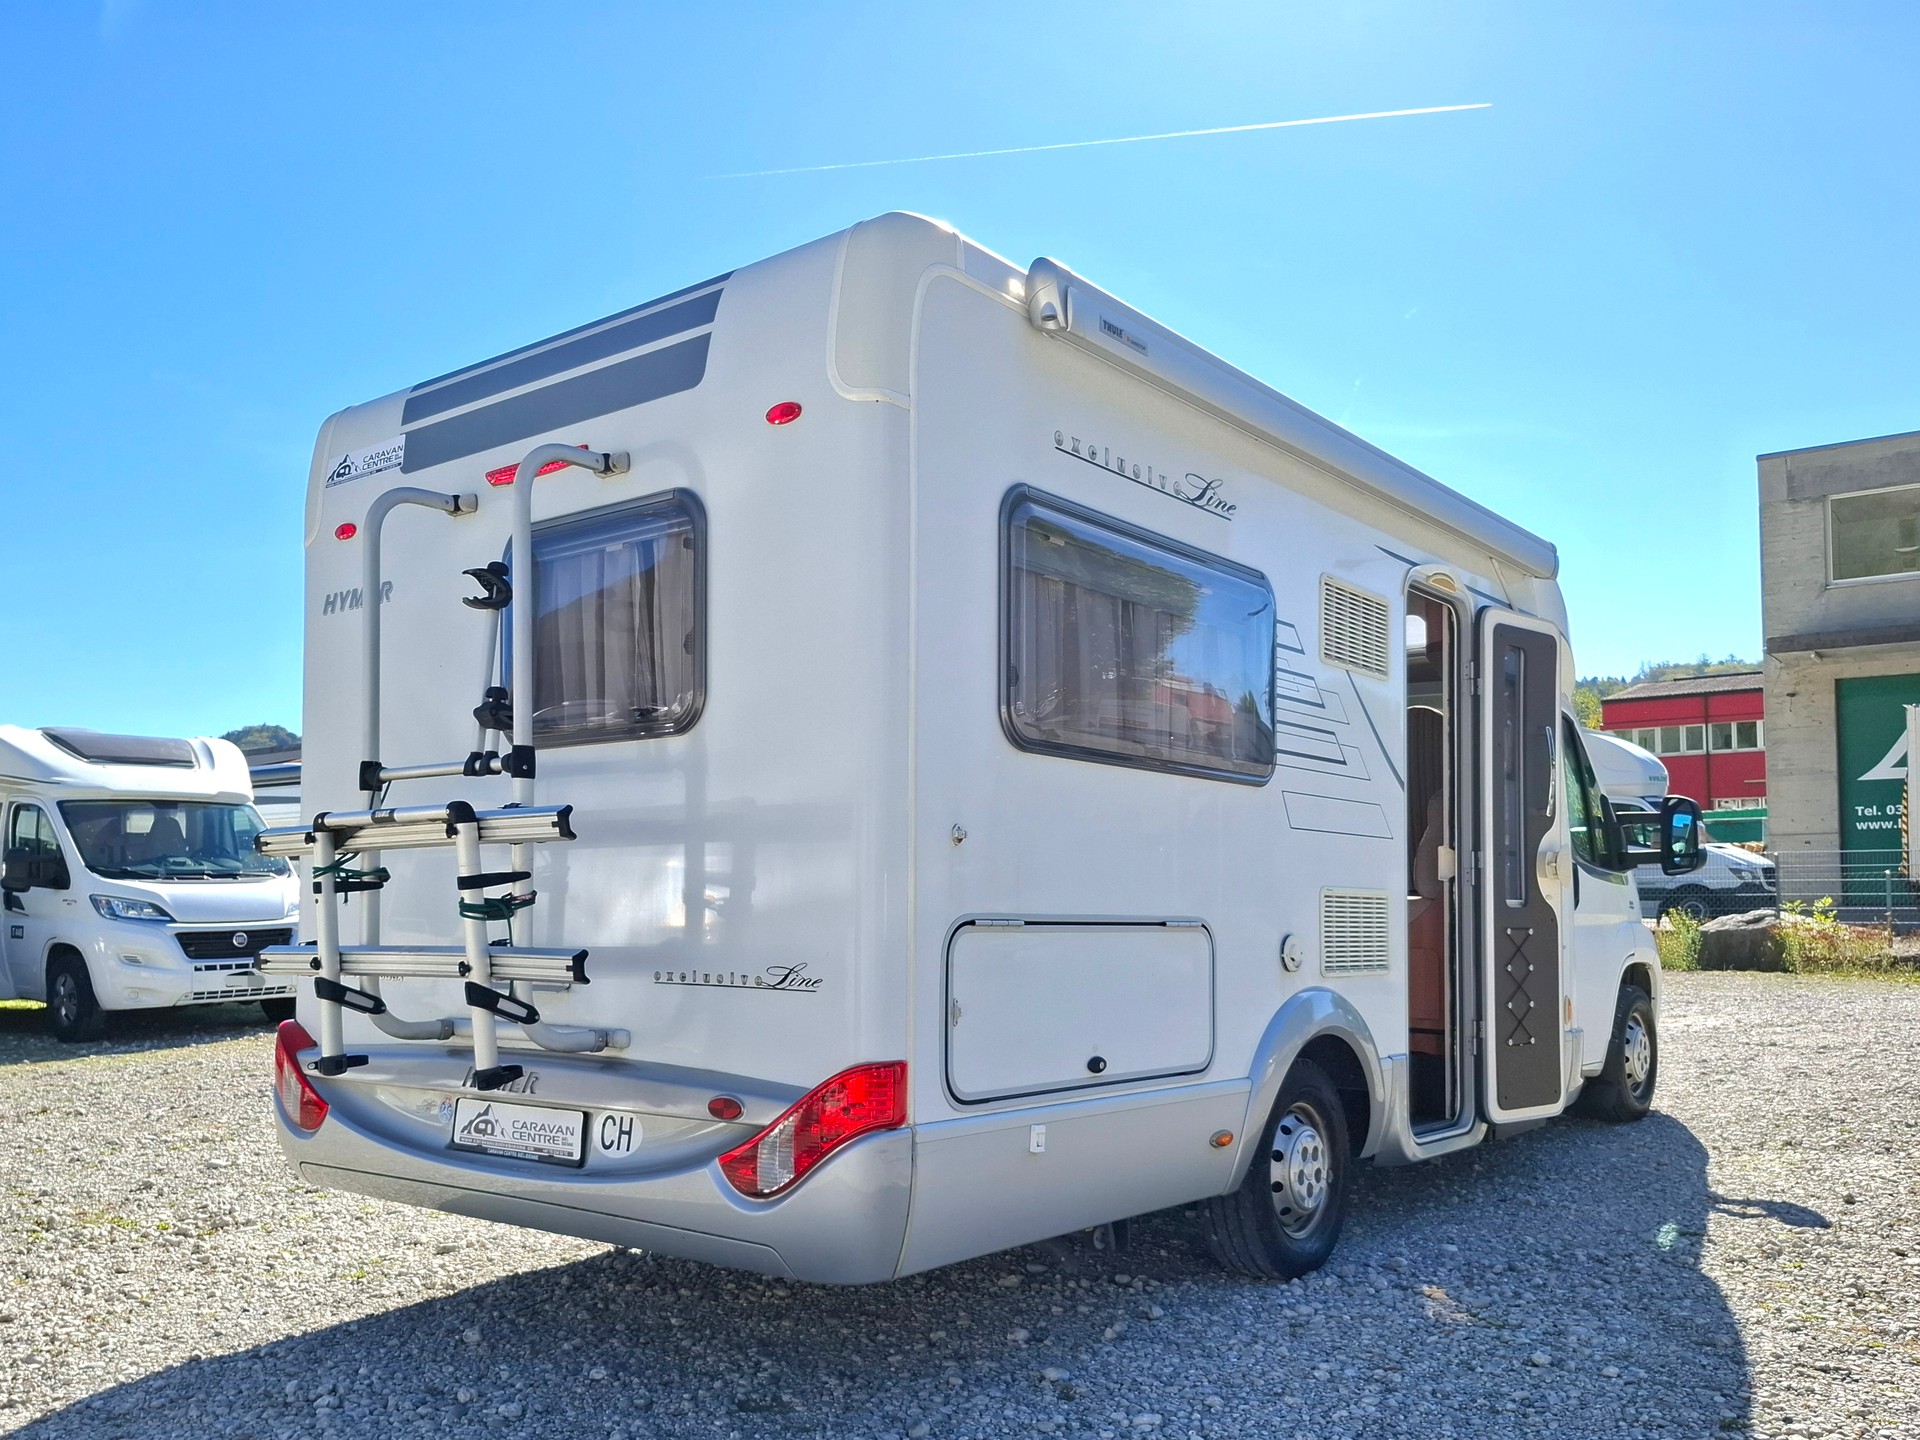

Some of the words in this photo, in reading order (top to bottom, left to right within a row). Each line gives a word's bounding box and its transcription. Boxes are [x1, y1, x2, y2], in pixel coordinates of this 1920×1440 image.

[363, 444, 404, 463] CARAVAN
[362, 455, 394, 471] CENTRE
[322, 580, 394, 616] HYMR
[1855, 805, 1881, 816] Tel.
[512, 1119, 575, 1137] CARAVAN
[601, 1114, 634, 1152] CH
[511, 1130, 561, 1146] CENTRE
